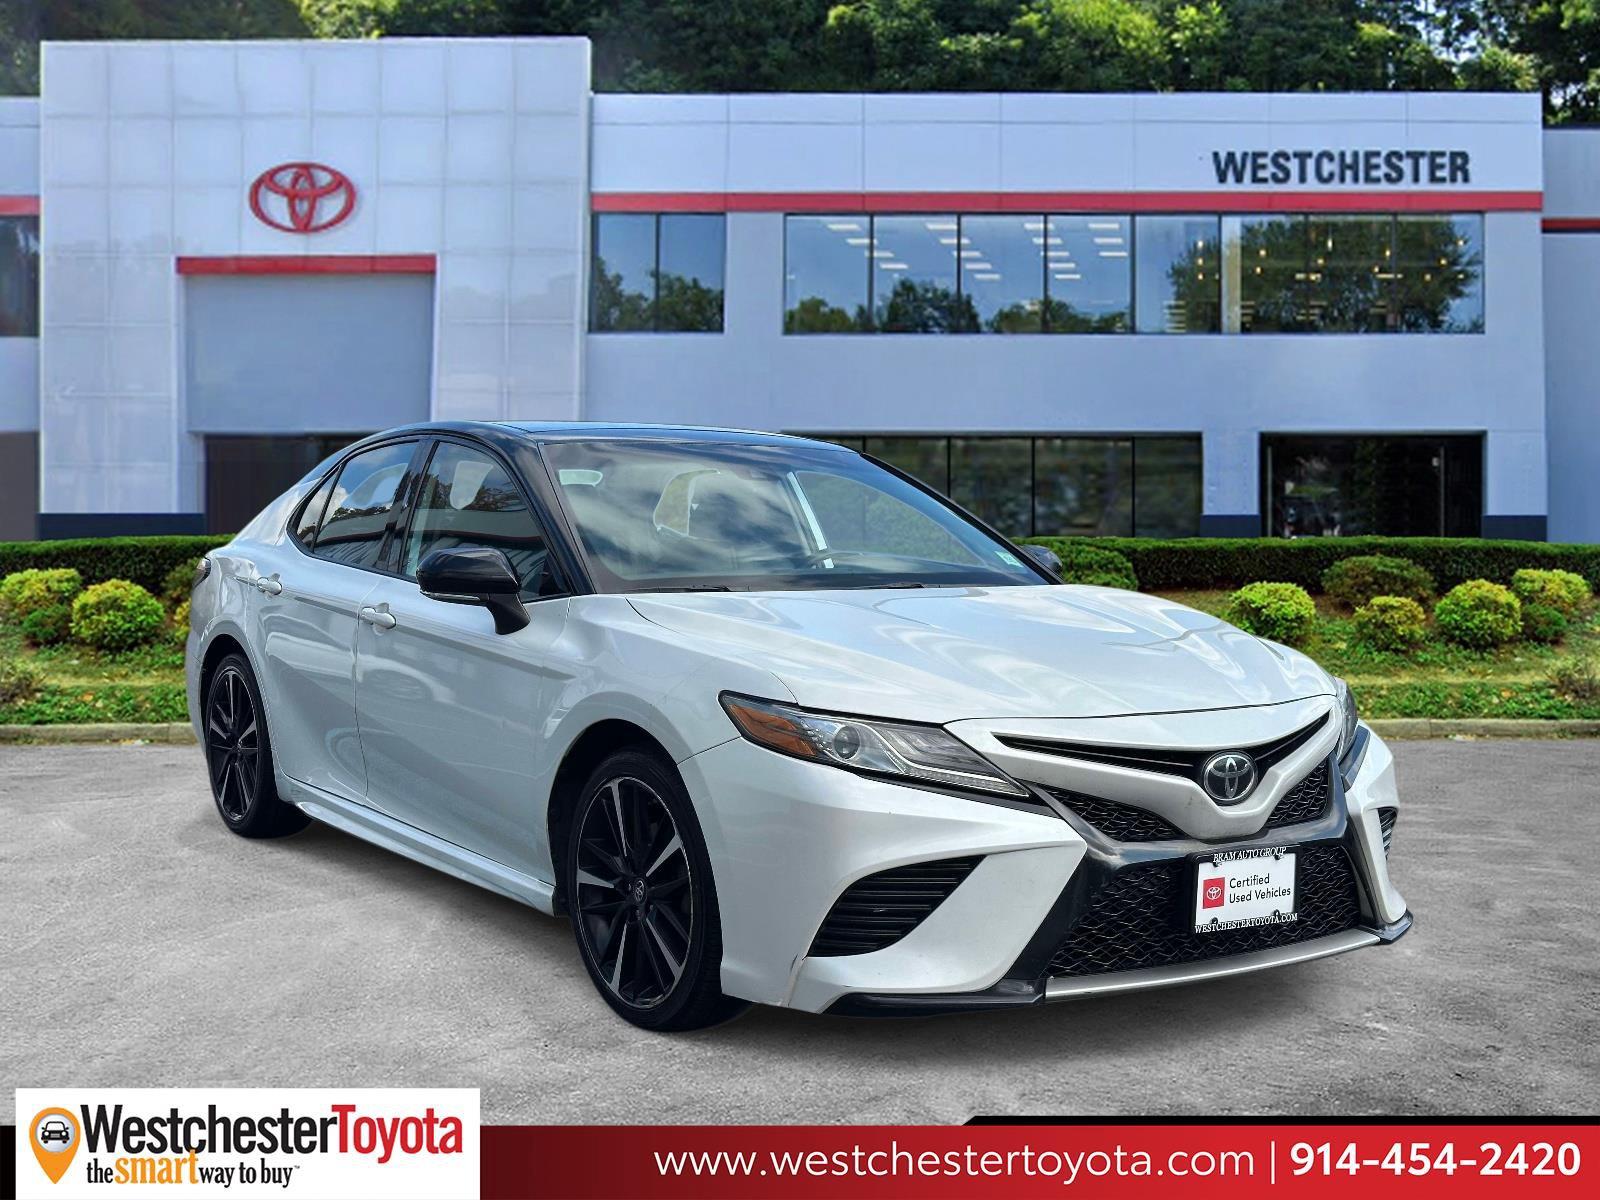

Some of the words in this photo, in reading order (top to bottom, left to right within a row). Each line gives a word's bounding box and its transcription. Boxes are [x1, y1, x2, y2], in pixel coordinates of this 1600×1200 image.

[1212, 150, 1471, 184] WESTCHESTER
[1237, 849, 1260, 860] AUTO
[1260, 846, 1287, 857] GROUP
[1229, 873, 1270, 889] Certified
[1229, 890, 1252, 904] Used
[1254, 887, 1291, 900] Vehicles
[1194, 912, 1298, 934] WESTCHESTERTOYOTA.COM
